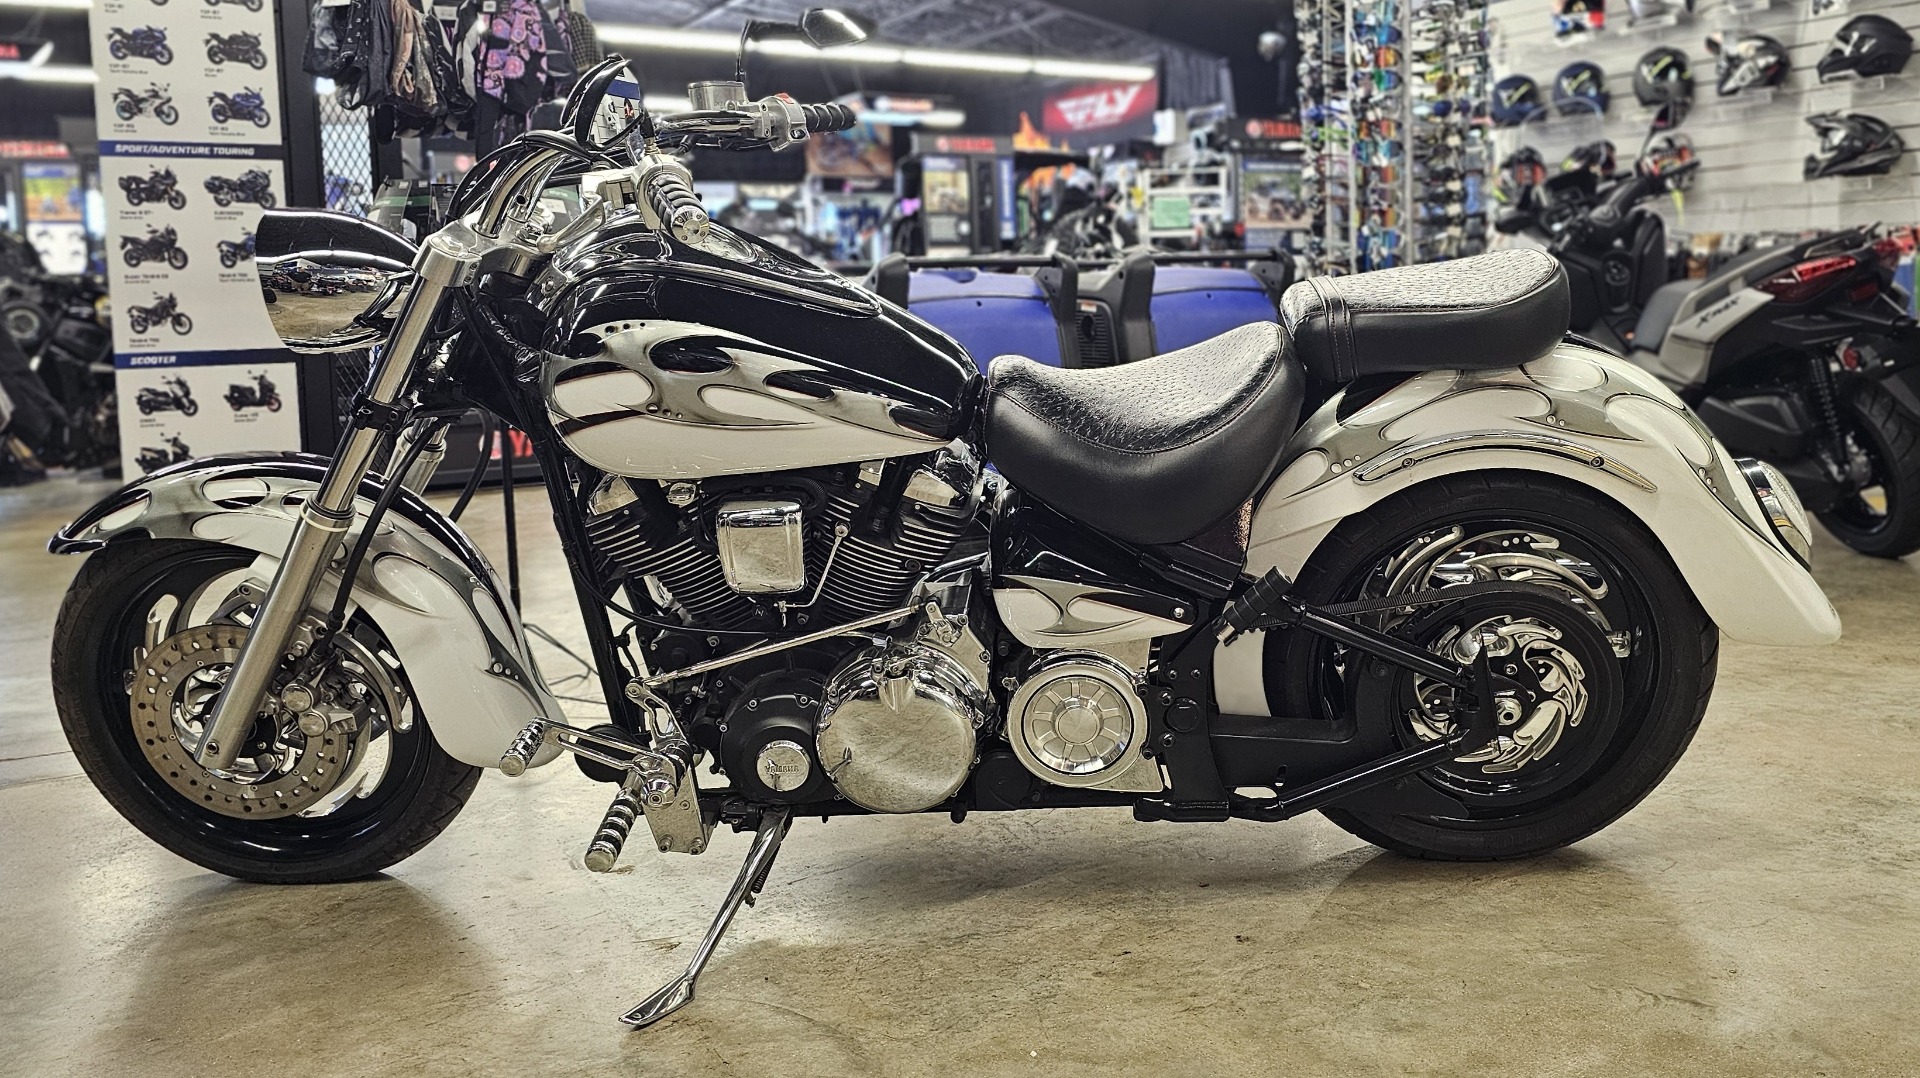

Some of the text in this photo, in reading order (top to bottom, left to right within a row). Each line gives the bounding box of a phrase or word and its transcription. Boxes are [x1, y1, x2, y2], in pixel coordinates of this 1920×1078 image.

[1056, 84, 1141, 122] FLY
[114, 143, 255, 157] SPORT/ADVENTURE TOURING
[130, 355, 177, 366] SCOOTER
[764, 764, 800, 774] YAMAHA
